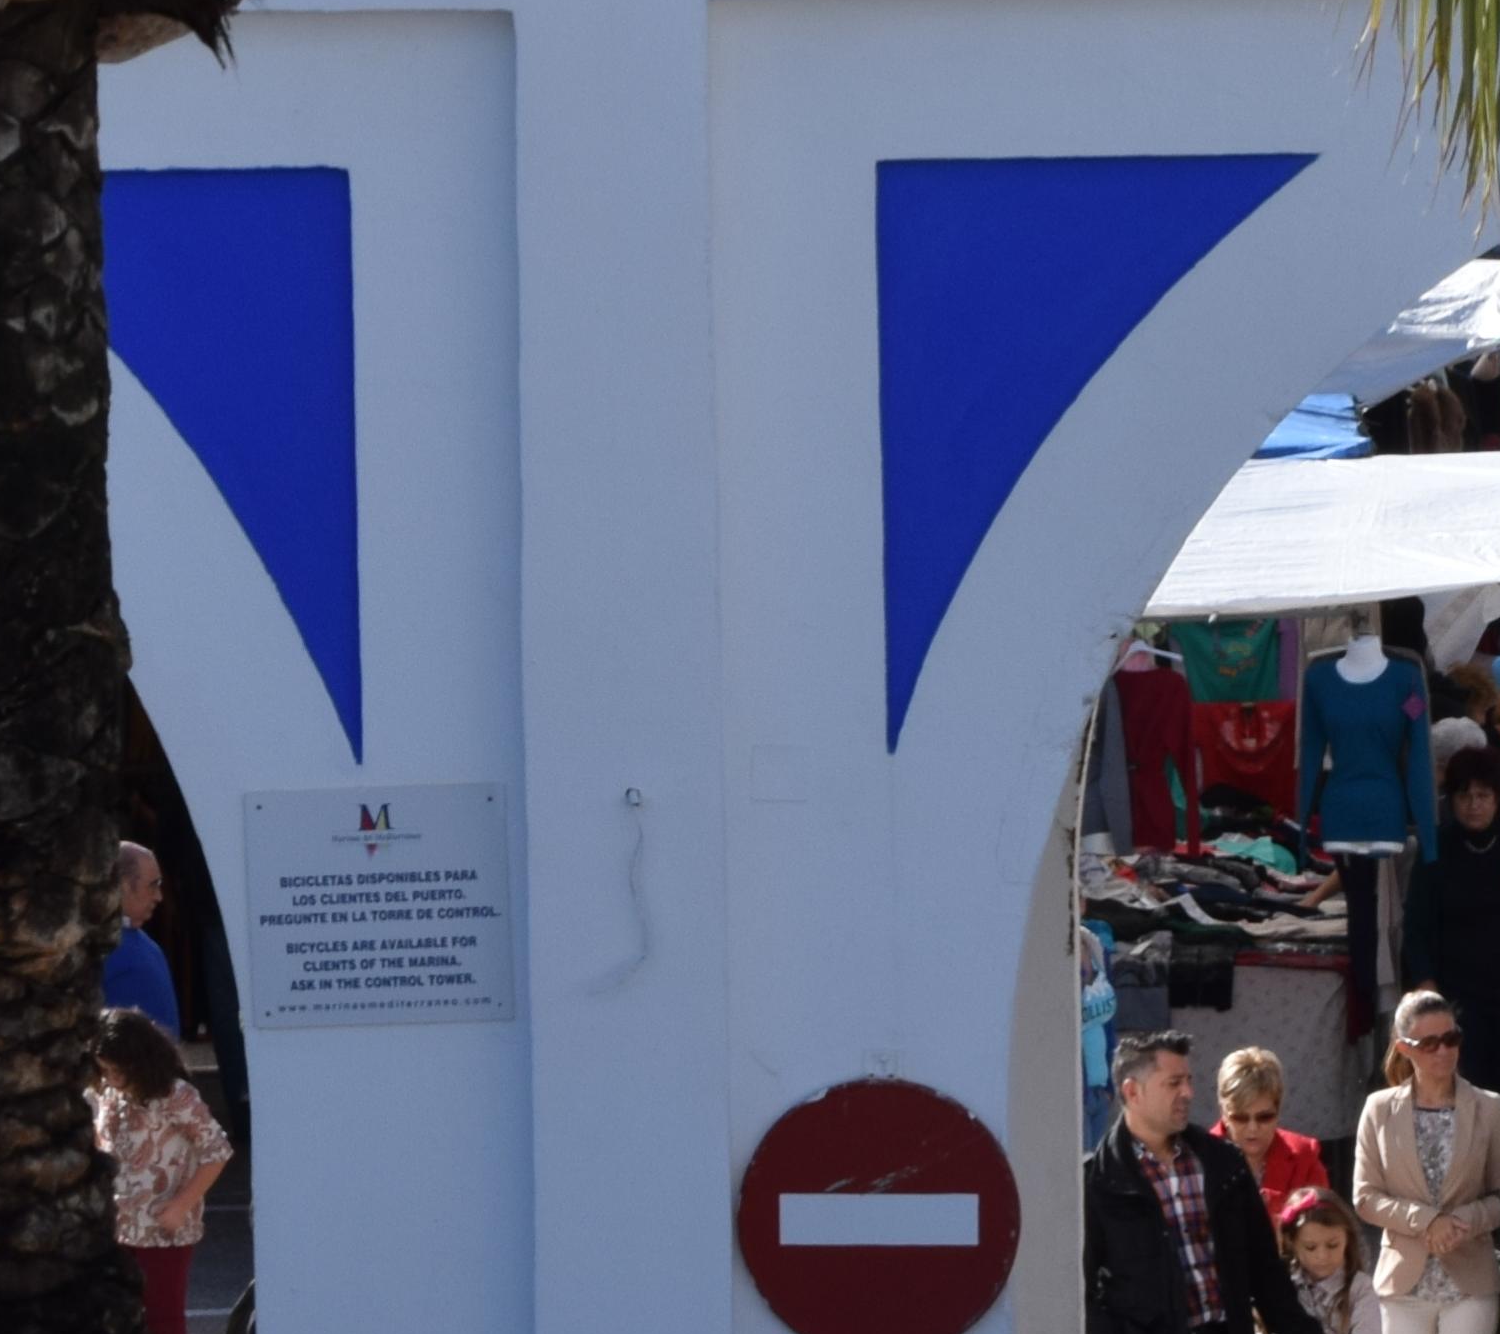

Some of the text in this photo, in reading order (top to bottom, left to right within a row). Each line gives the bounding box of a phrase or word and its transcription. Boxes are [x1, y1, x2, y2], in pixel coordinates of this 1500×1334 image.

[279, 869, 478, 888] BICICLETAS DISPONIBLES PARA
[292, 888, 466, 907] LOS CLIENTES DEL PUERTO.
[260, 905, 501, 926] PREGUNTE EN LA TORRE DE CONTROL.
[286, 935, 477, 955] BICYCLES ARE AVAILABLE FOR
[303, 954, 462, 972] CLIENTS OF THE MARINA.
[290, 972, 477, 992] ASK IN THE CONTROL TOWER.
